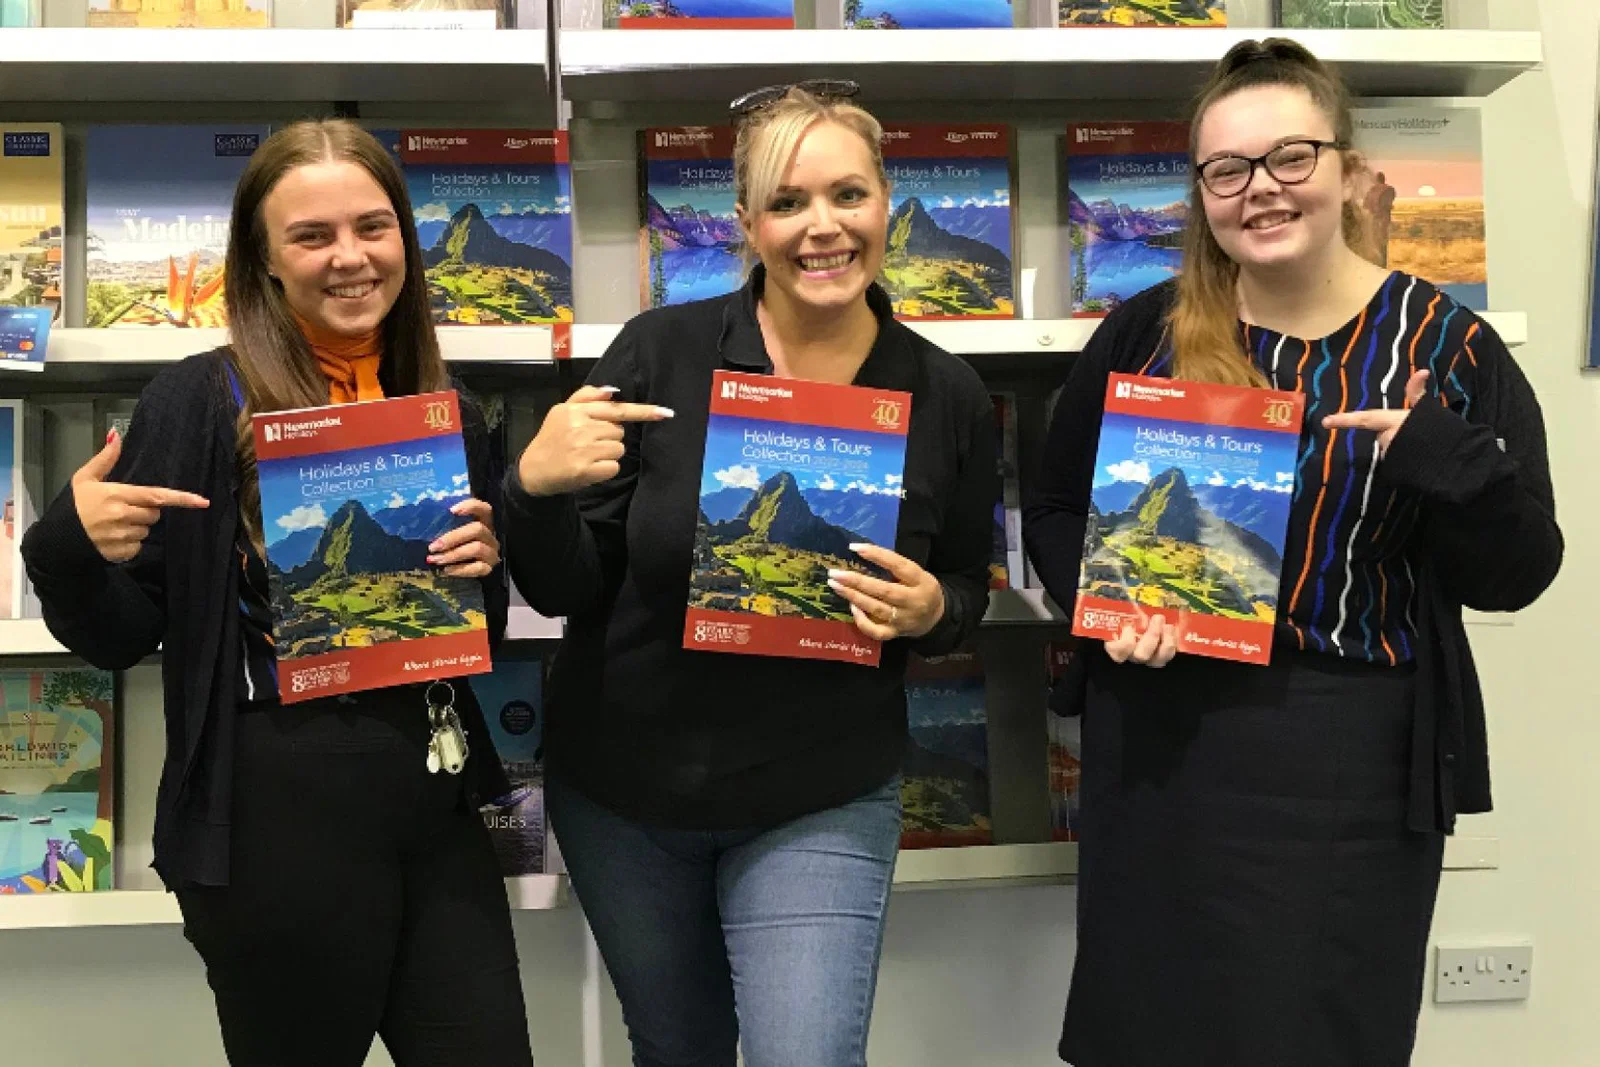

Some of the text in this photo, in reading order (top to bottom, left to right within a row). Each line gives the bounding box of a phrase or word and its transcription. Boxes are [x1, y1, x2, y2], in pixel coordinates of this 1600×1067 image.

[679, 167, 735, 180] Holidays
[932, 165, 942, 178] &
[945, 165, 981, 178] Tours
[1099, 161, 1154, 174] Holidays
[1157, 161, 1167, 173] &
[431, 172, 541, 186] Holidays & Tours
[431, 185, 491, 197] Collection
[739, 383, 793, 398] Newmarket
[1133, 384, 1186, 398] Newmarket
[283, 416, 342, 432] Newmarket
[424, 402, 450, 427] 40
[871, 403, 900, 425] 40
[1262, 402, 1293, 426] 40
[743, 428, 873, 457] Holidays & Tours
[1136, 426, 1263, 454] Holidays & Tours
[742, 444, 811, 465] Collection
[1133, 441, 1201, 461] Collection
[299, 451, 434, 482] Holidays & Tours
[301, 476, 375, 497] Collection
